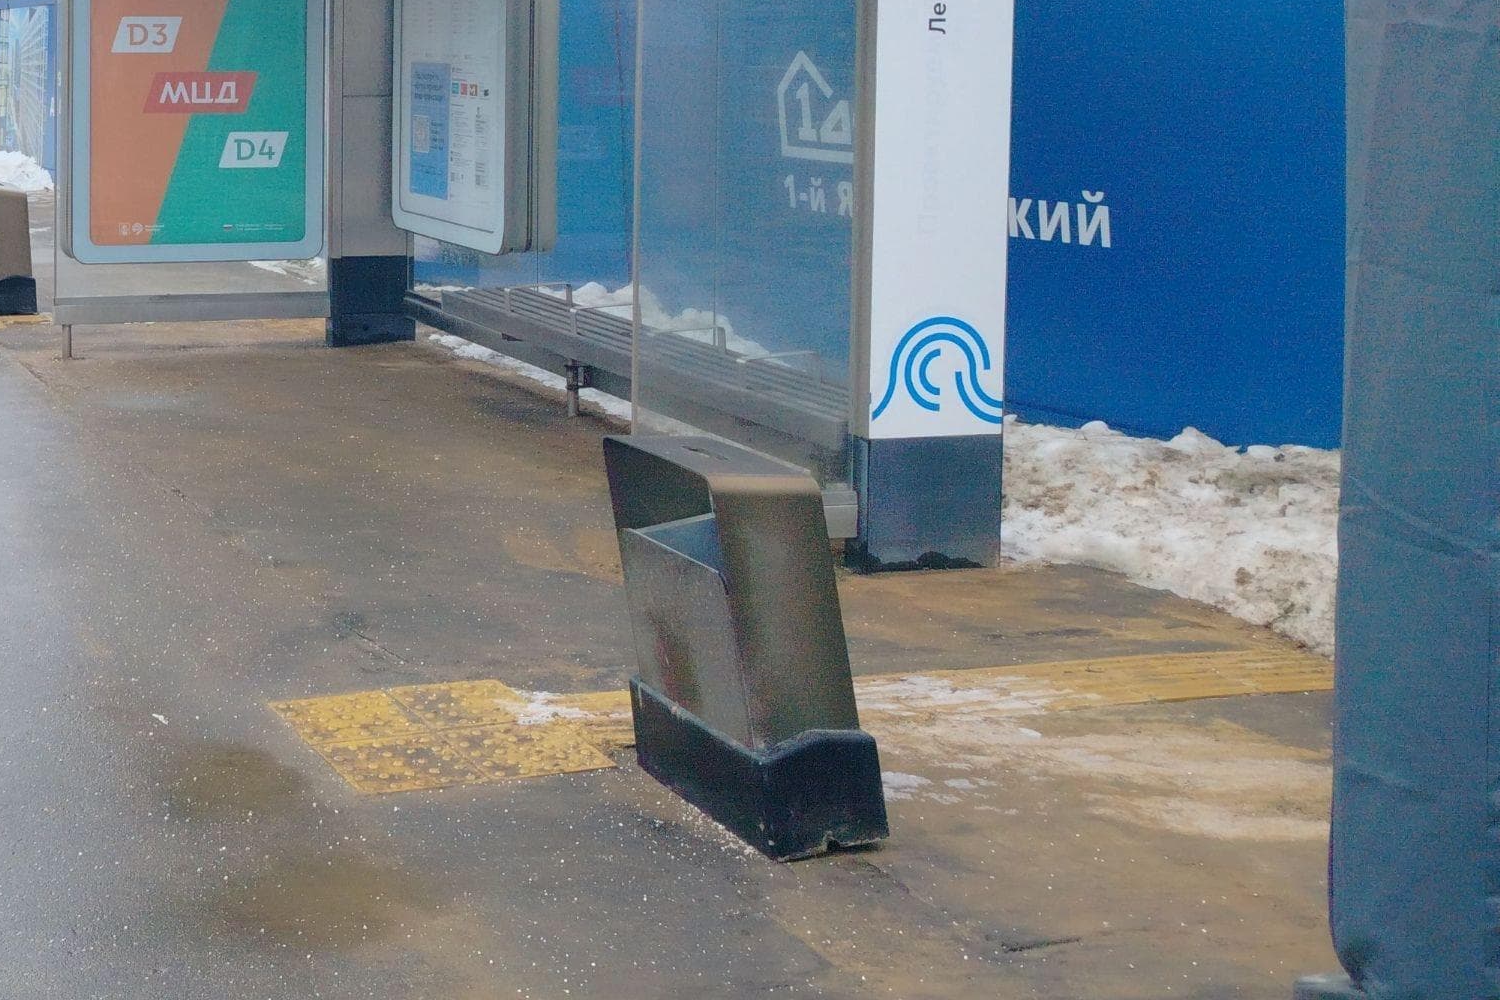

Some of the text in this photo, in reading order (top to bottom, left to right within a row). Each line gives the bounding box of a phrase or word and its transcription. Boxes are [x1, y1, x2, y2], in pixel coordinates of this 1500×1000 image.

[126, 23, 168, 47] D3
[159, 81, 240, 104] МЦД
[233, 138, 276, 161] D4
